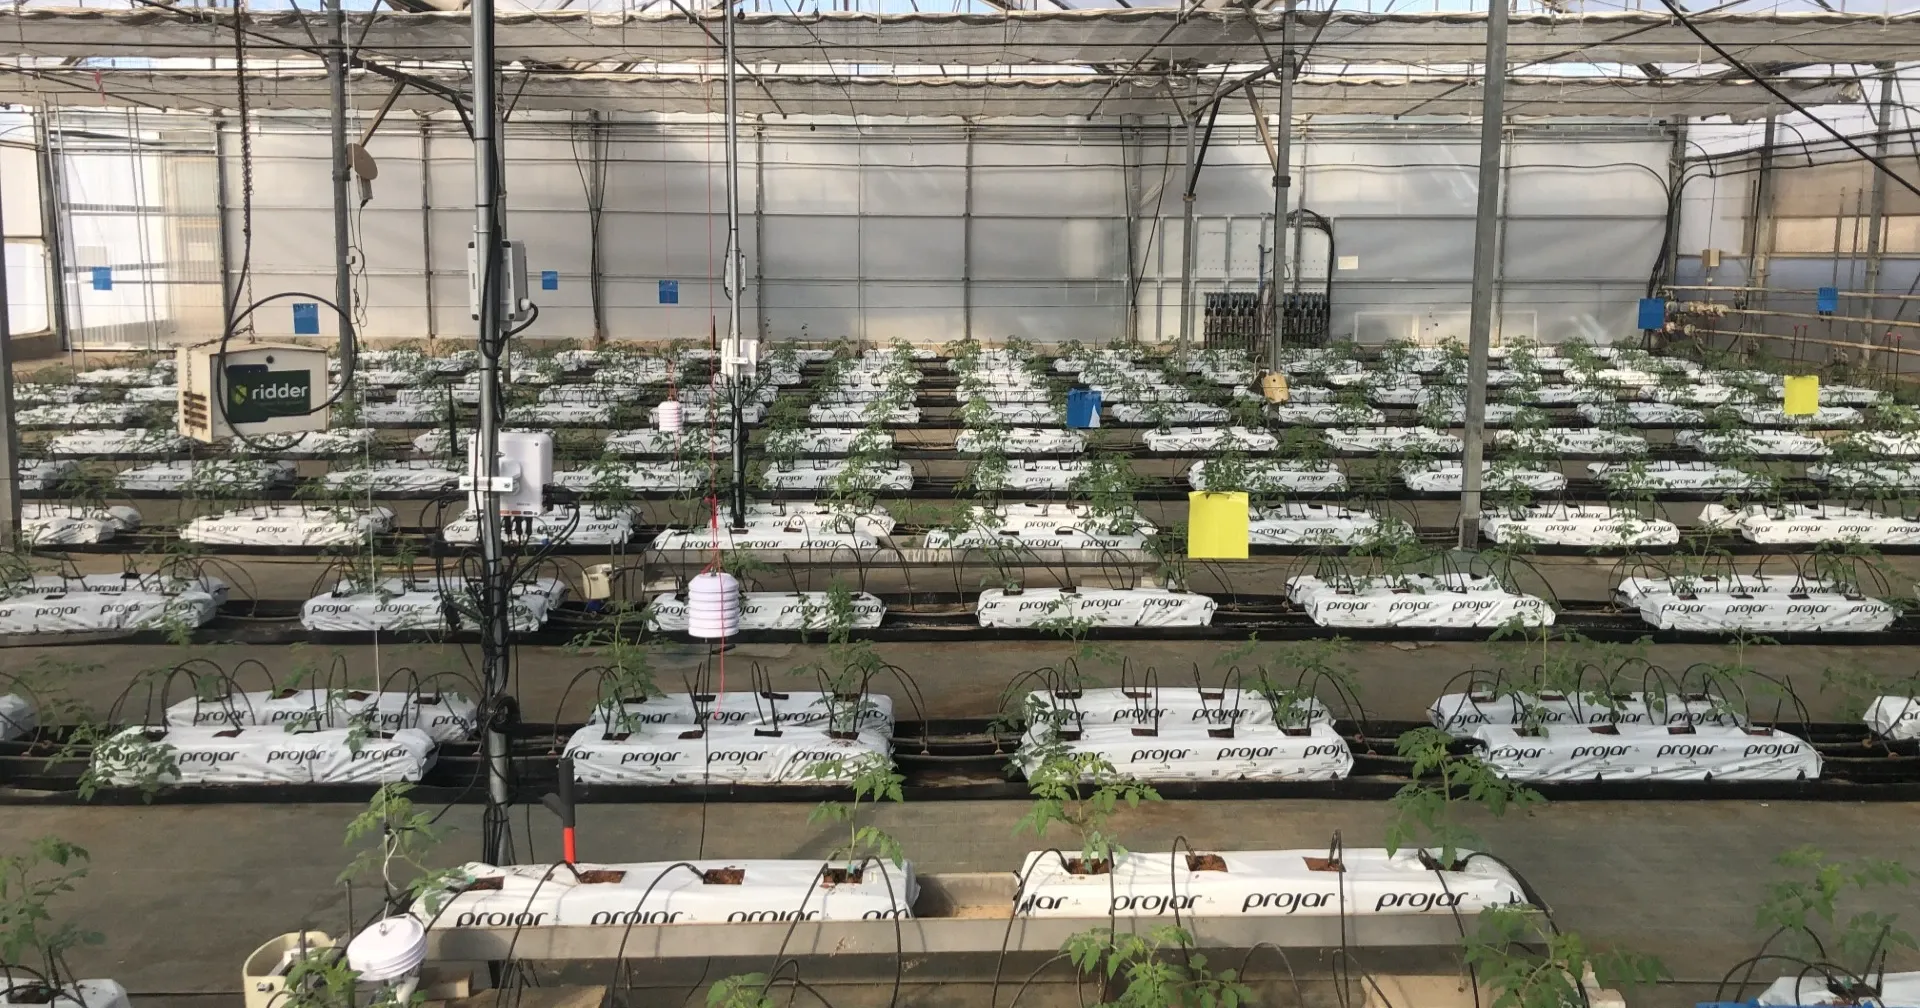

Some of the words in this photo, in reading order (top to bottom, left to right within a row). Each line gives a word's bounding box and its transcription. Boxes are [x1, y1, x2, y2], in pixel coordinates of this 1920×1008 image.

[252, 383, 308, 400] ridder
[207, 525, 241, 533] projar
[256, 525, 289, 533] projar
[1025, 520, 1058, 528] projar
[1545, 525, 1578, 533] projar
[1641, 525, 1672, 533] projar
[1788, 525, 1822, 533] projar
[1838, 525, 1872, 534] projar
[1304, 527, 1338, 535] projar
[681, 540, 722, 550] projar
[800, 540, 842, 549] projar
[1022, 538, 1062, 548] projar
[1081, 538, 1122, 548] projar
[312, 604, 355, 615] projar
[1081, 598, 1124, 610] projar
[1143, 597, 1184, 608] projar
[1326, 602, 1370, 613] projar
[1389, 602, 1433, 613] projar
[1452, 601, 1496, 613] projar
[1660, 604, 1707, 615] projar
[1725, 604, 1770, 615] projar
[1787, 604, 1832, 615] projar
[36, 606, 81, 618] projar
[194, 710, 248, 726] projar
[272, 710, 328, 724] projar
[1113, 709, 1168, 723] projar
[1192, 708, 1247, 723] projar
[179, 750, 239, 766] projar
[267, 748, 327, 765] projar
[352, 747, 408, 763] projar
[1131, 749, 1191, 764] projar
[1217, 747, 1278, 761] projar
[1571, 745, 1632, 760] projar
[1656, 743, 1718, 759] projar
[621, 751, 681, 765] projar
[708, 751, 769, 765] projar
[1109, 895, 1202, 915] projar
[1242, 892, 1335, 914] projar
[1376, 892, 1468, 912] projar
[456, 911, 548, 927] projar
[591, 910, 684, 926] projar
